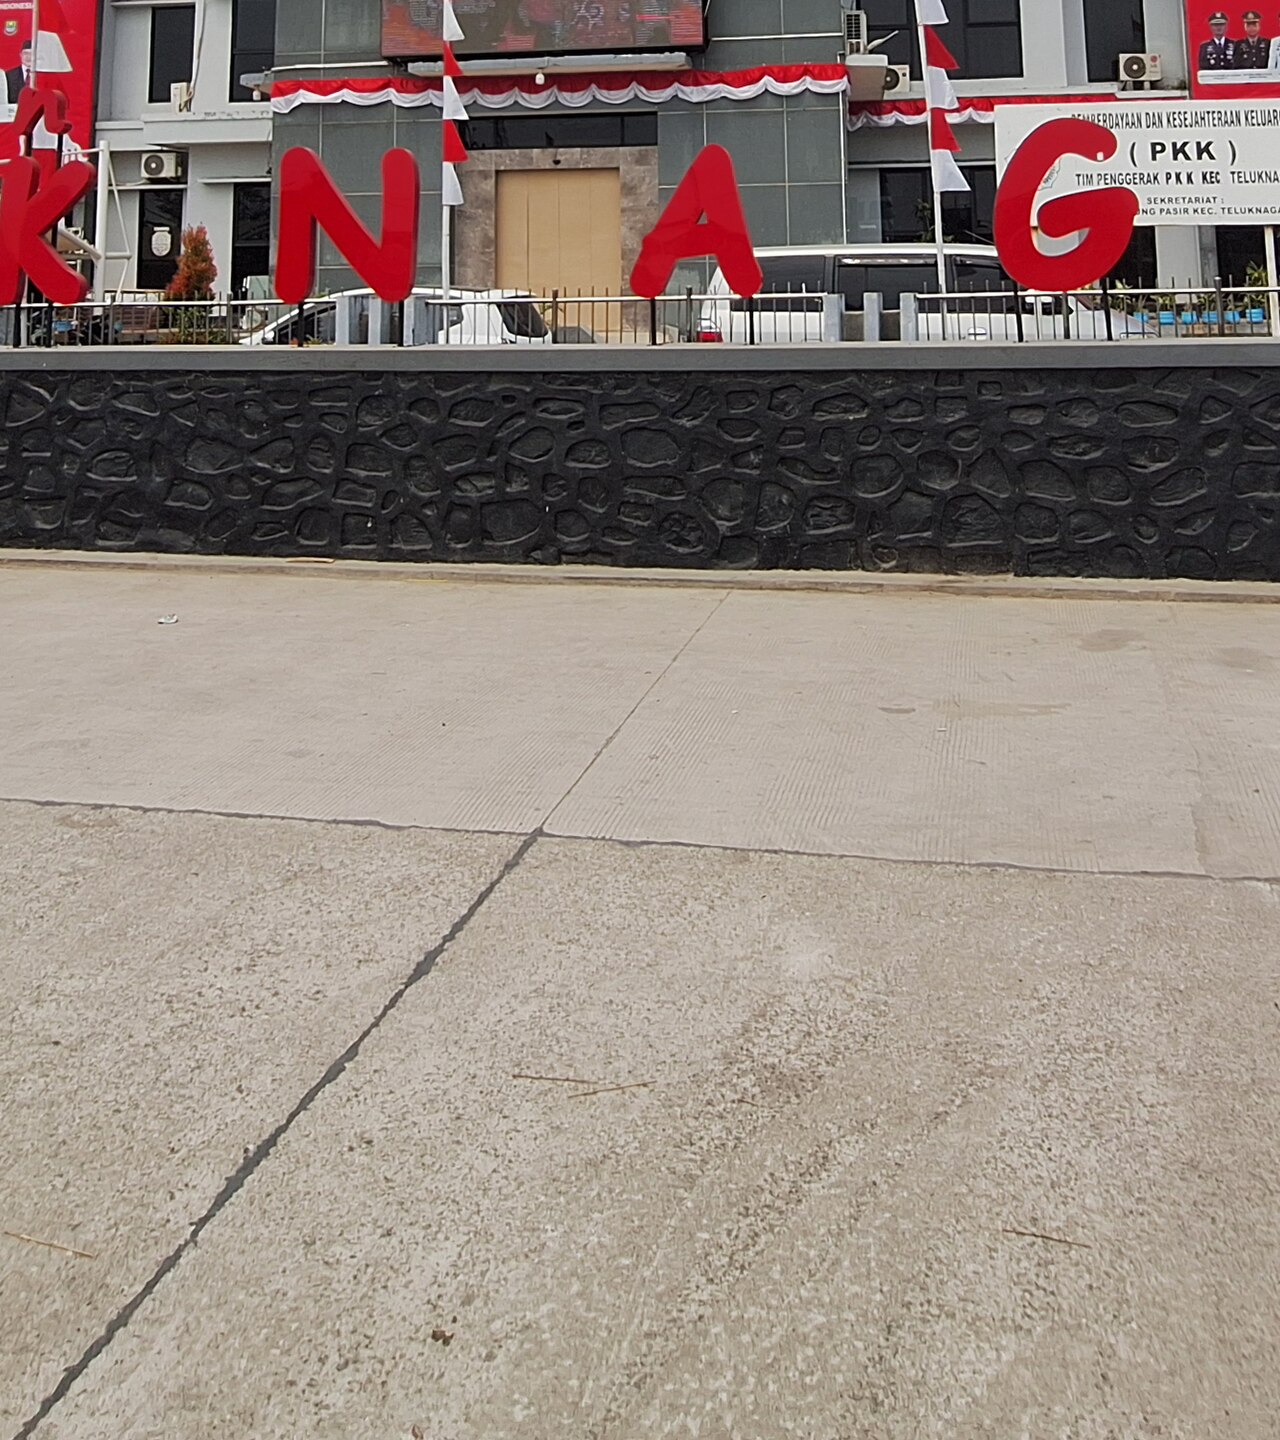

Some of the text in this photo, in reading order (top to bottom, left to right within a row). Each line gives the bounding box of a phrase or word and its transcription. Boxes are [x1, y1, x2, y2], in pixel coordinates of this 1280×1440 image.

[1071, 112, 1143, 130] BERDAYAAN
[1145, 111, 1163, 129] DAN
[1166, 109, 1242, 129] KESEJAHTERAAN
[1075, 173, 1094, 186] TIM
[1097, 172, 1161, 186] PENGGERAK
[1201, 171, 1221, 185] KEC
[1146, 196, 1218, 205] SEKRETARIAT
[1159, 207, 1190, 216] PASIR
[1193, 207, 1218, 215] KEC.
